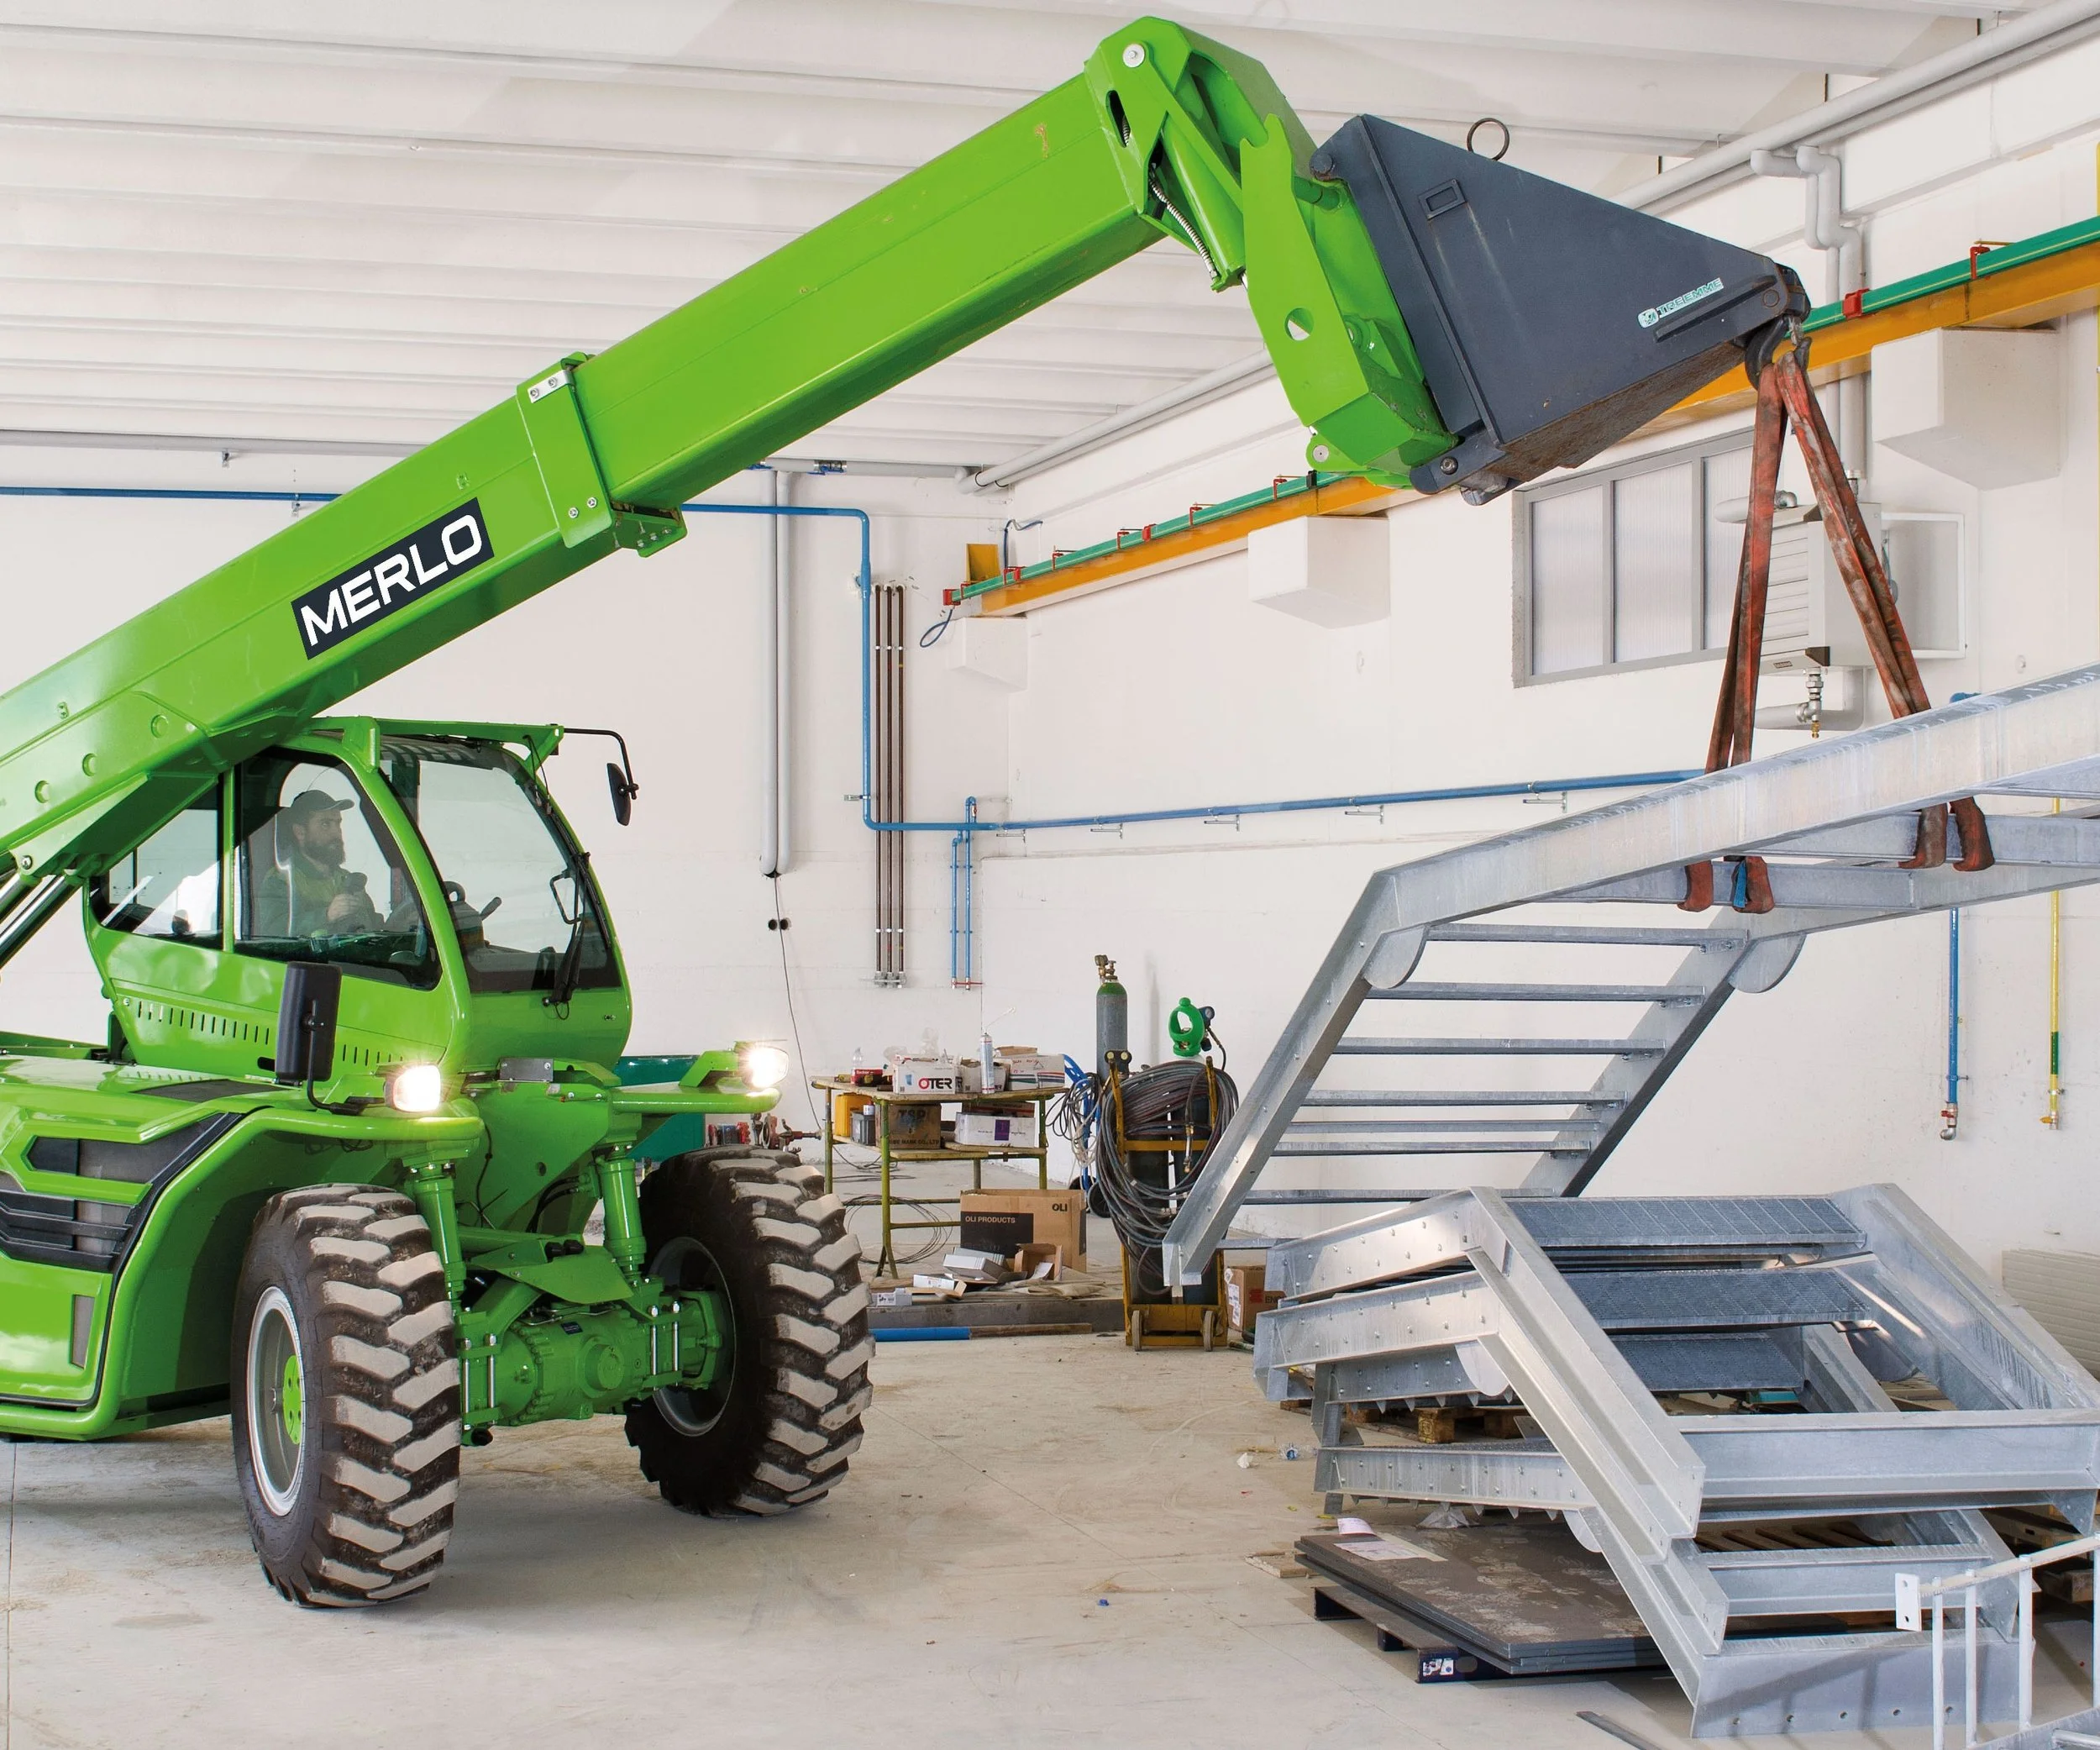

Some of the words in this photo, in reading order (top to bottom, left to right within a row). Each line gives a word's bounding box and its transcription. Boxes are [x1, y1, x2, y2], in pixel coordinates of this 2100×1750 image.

[1658, 278, 1723, 315] TREEMME
[300, 514, 482, 647] MERLO
[918, 1077, 953, 1090] OTER
[1052, 1203, 1068, 1212] OLI
[978, 1216, 1016, 1224] PRODUCTS
